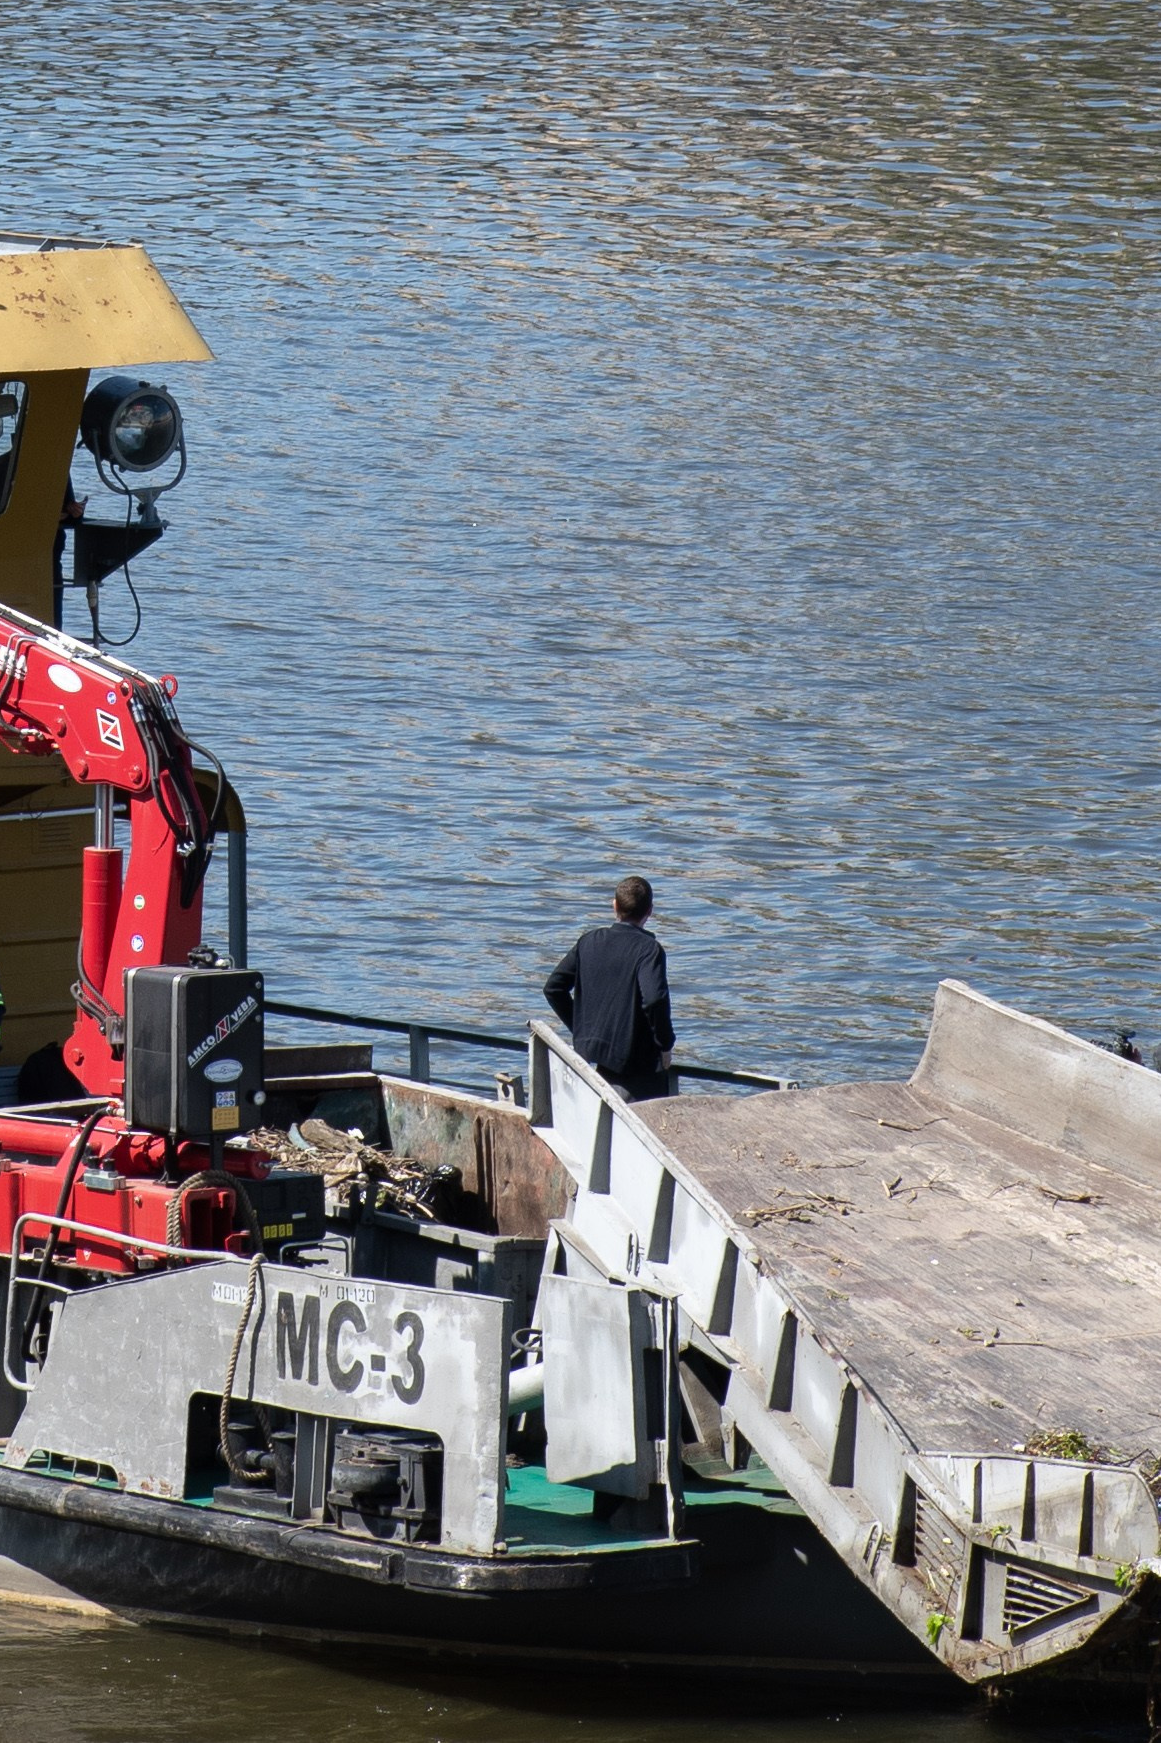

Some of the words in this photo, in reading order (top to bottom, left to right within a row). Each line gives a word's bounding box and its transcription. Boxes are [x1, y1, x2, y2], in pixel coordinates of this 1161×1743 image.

[187, 1034, 216, 1067] AMCO
[230, 995, 256, 1022] VEBA
[276, 1291, 425, 1405] МС-3
